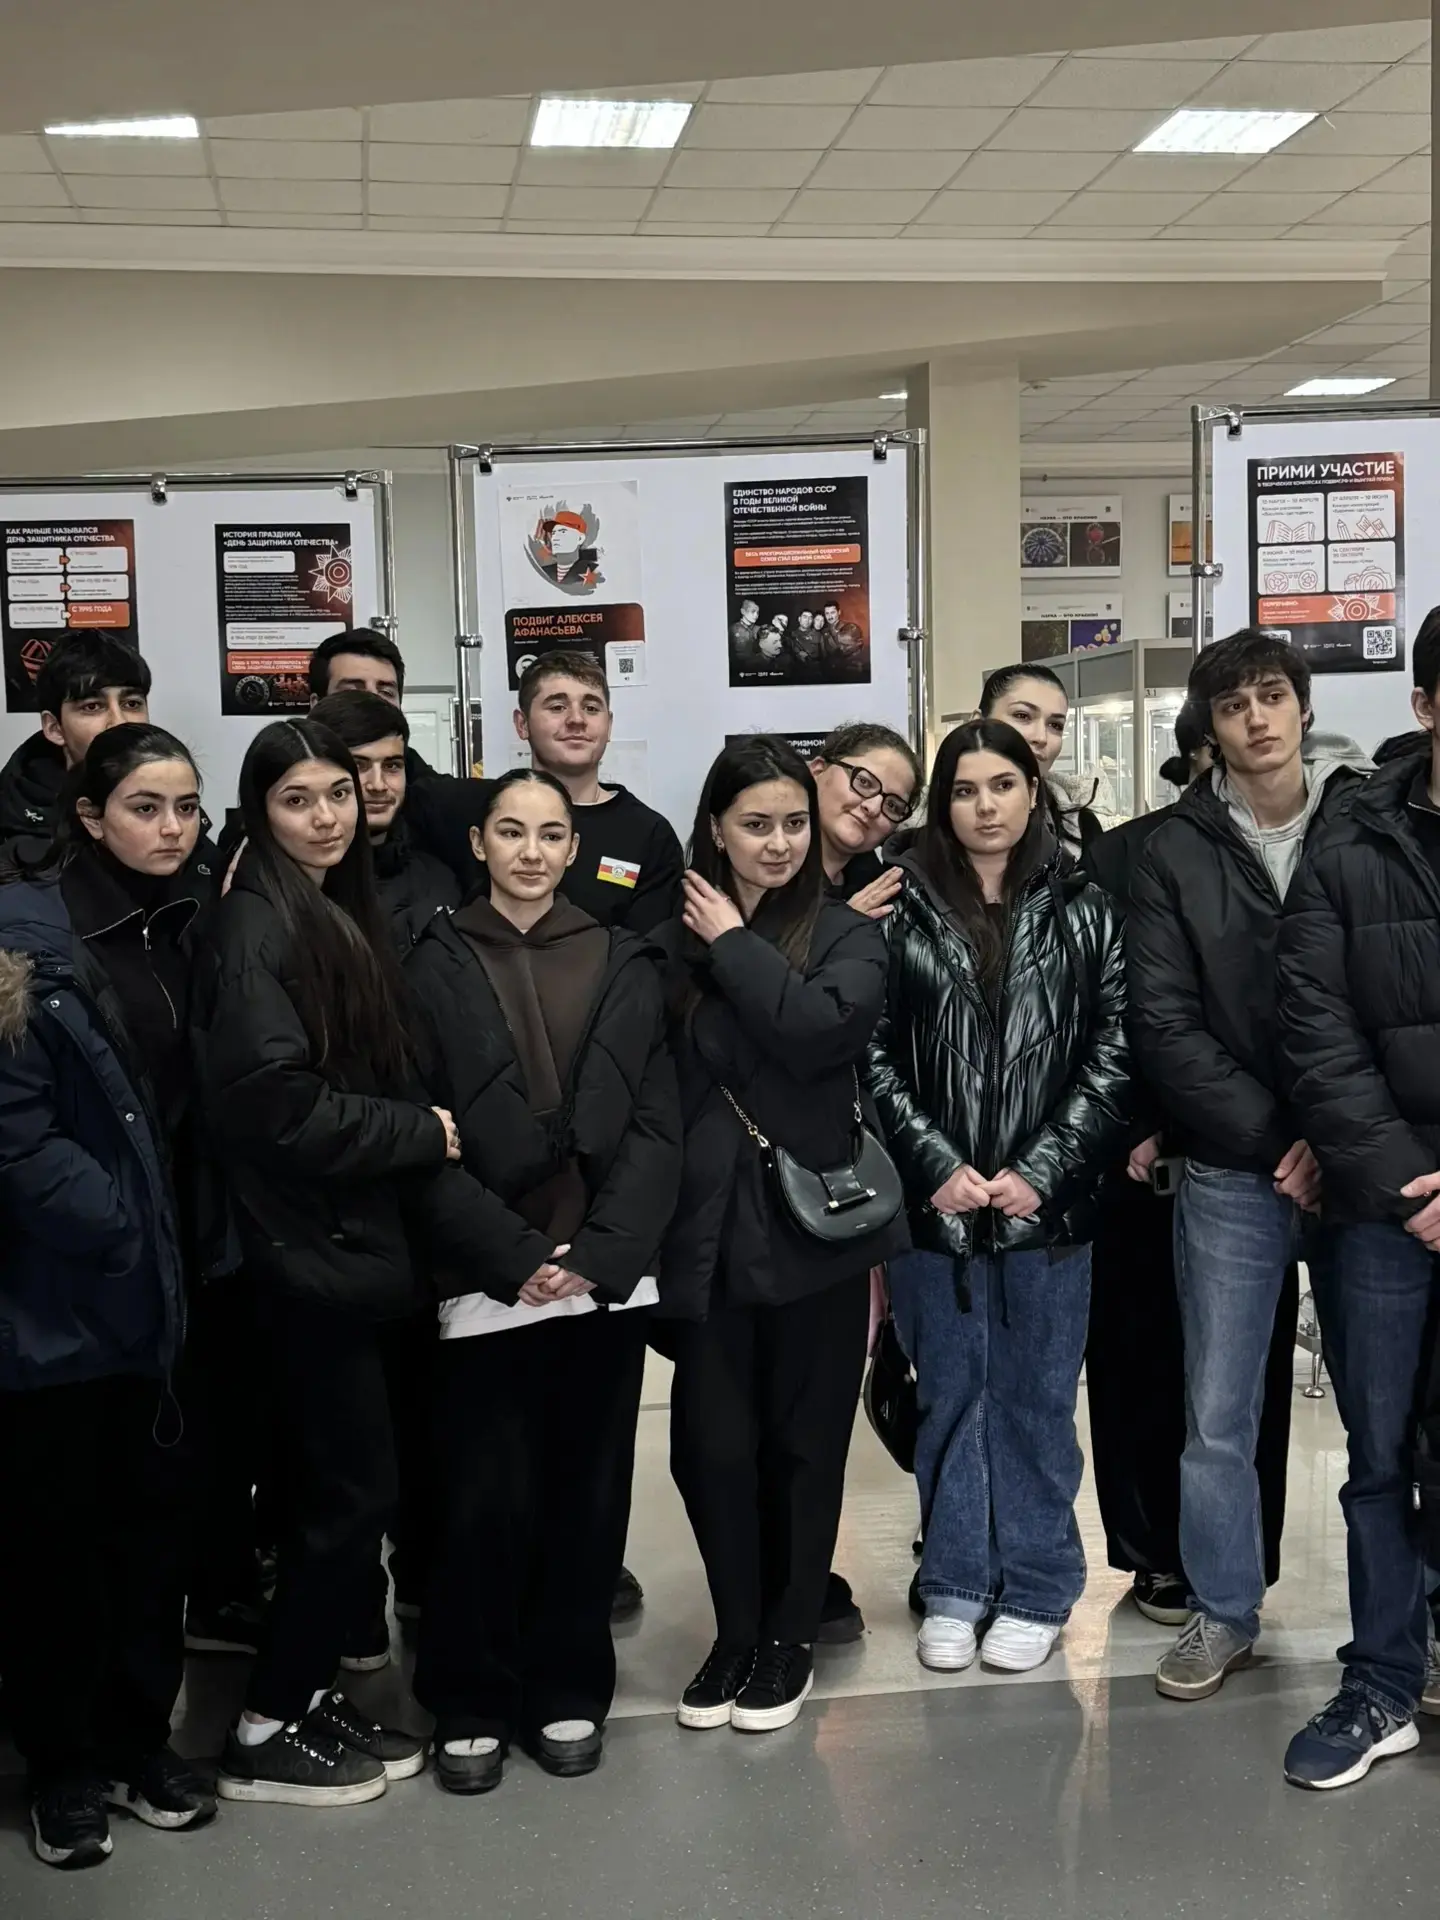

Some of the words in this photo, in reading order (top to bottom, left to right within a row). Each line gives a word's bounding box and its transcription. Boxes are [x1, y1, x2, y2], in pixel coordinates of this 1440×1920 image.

[1257, 464, 1315, 480] ПРИМИ
[1320, 461, 1395, 478] УЧАСТИЕ
[733, 488, 774, 497] ЕДИНСТВО
[776, 486, 813, 494] НАРОДОВ
[740, 498, 762, 506] ГОДЫ
[763, 495, 798, 504] ВЕЛИКОЙ
[733, 504, 798, 514] ОТЕЧЕСТВЕННОЙ
[799, 503, 828, 512] ВОЙНЫ
[513, 616, 554, 626] ПОДВИГ
[557, 614, 603, 624] АЛЕКСЕЯ
[514, 626, 584, 636] АФАНАСЬЕВА
